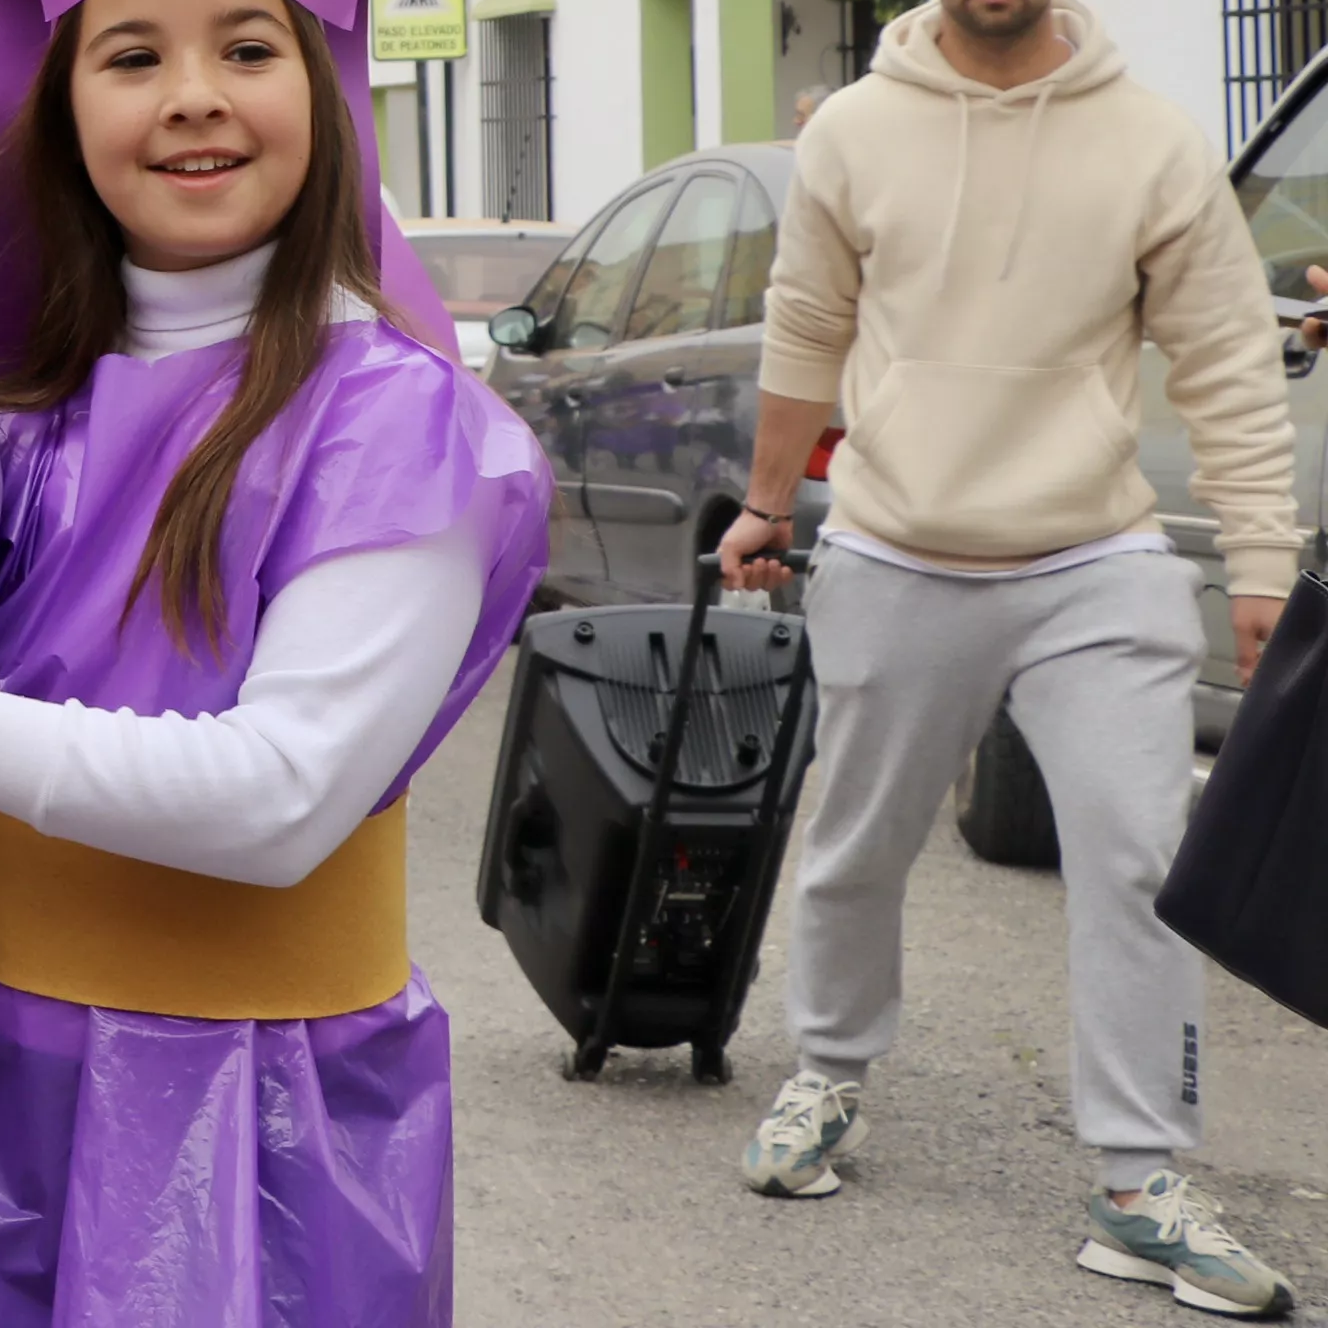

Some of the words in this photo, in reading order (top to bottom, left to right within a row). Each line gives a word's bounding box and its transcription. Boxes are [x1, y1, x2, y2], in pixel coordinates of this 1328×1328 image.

[378, 26, 406, 37] PASO
[411, 24, 461, 37] ELEVADO
[381, 41, 395, 52] DE
[400, 40, 457, 51] PEATONES
[1182, 1022, 1198, 1105] GUESS
